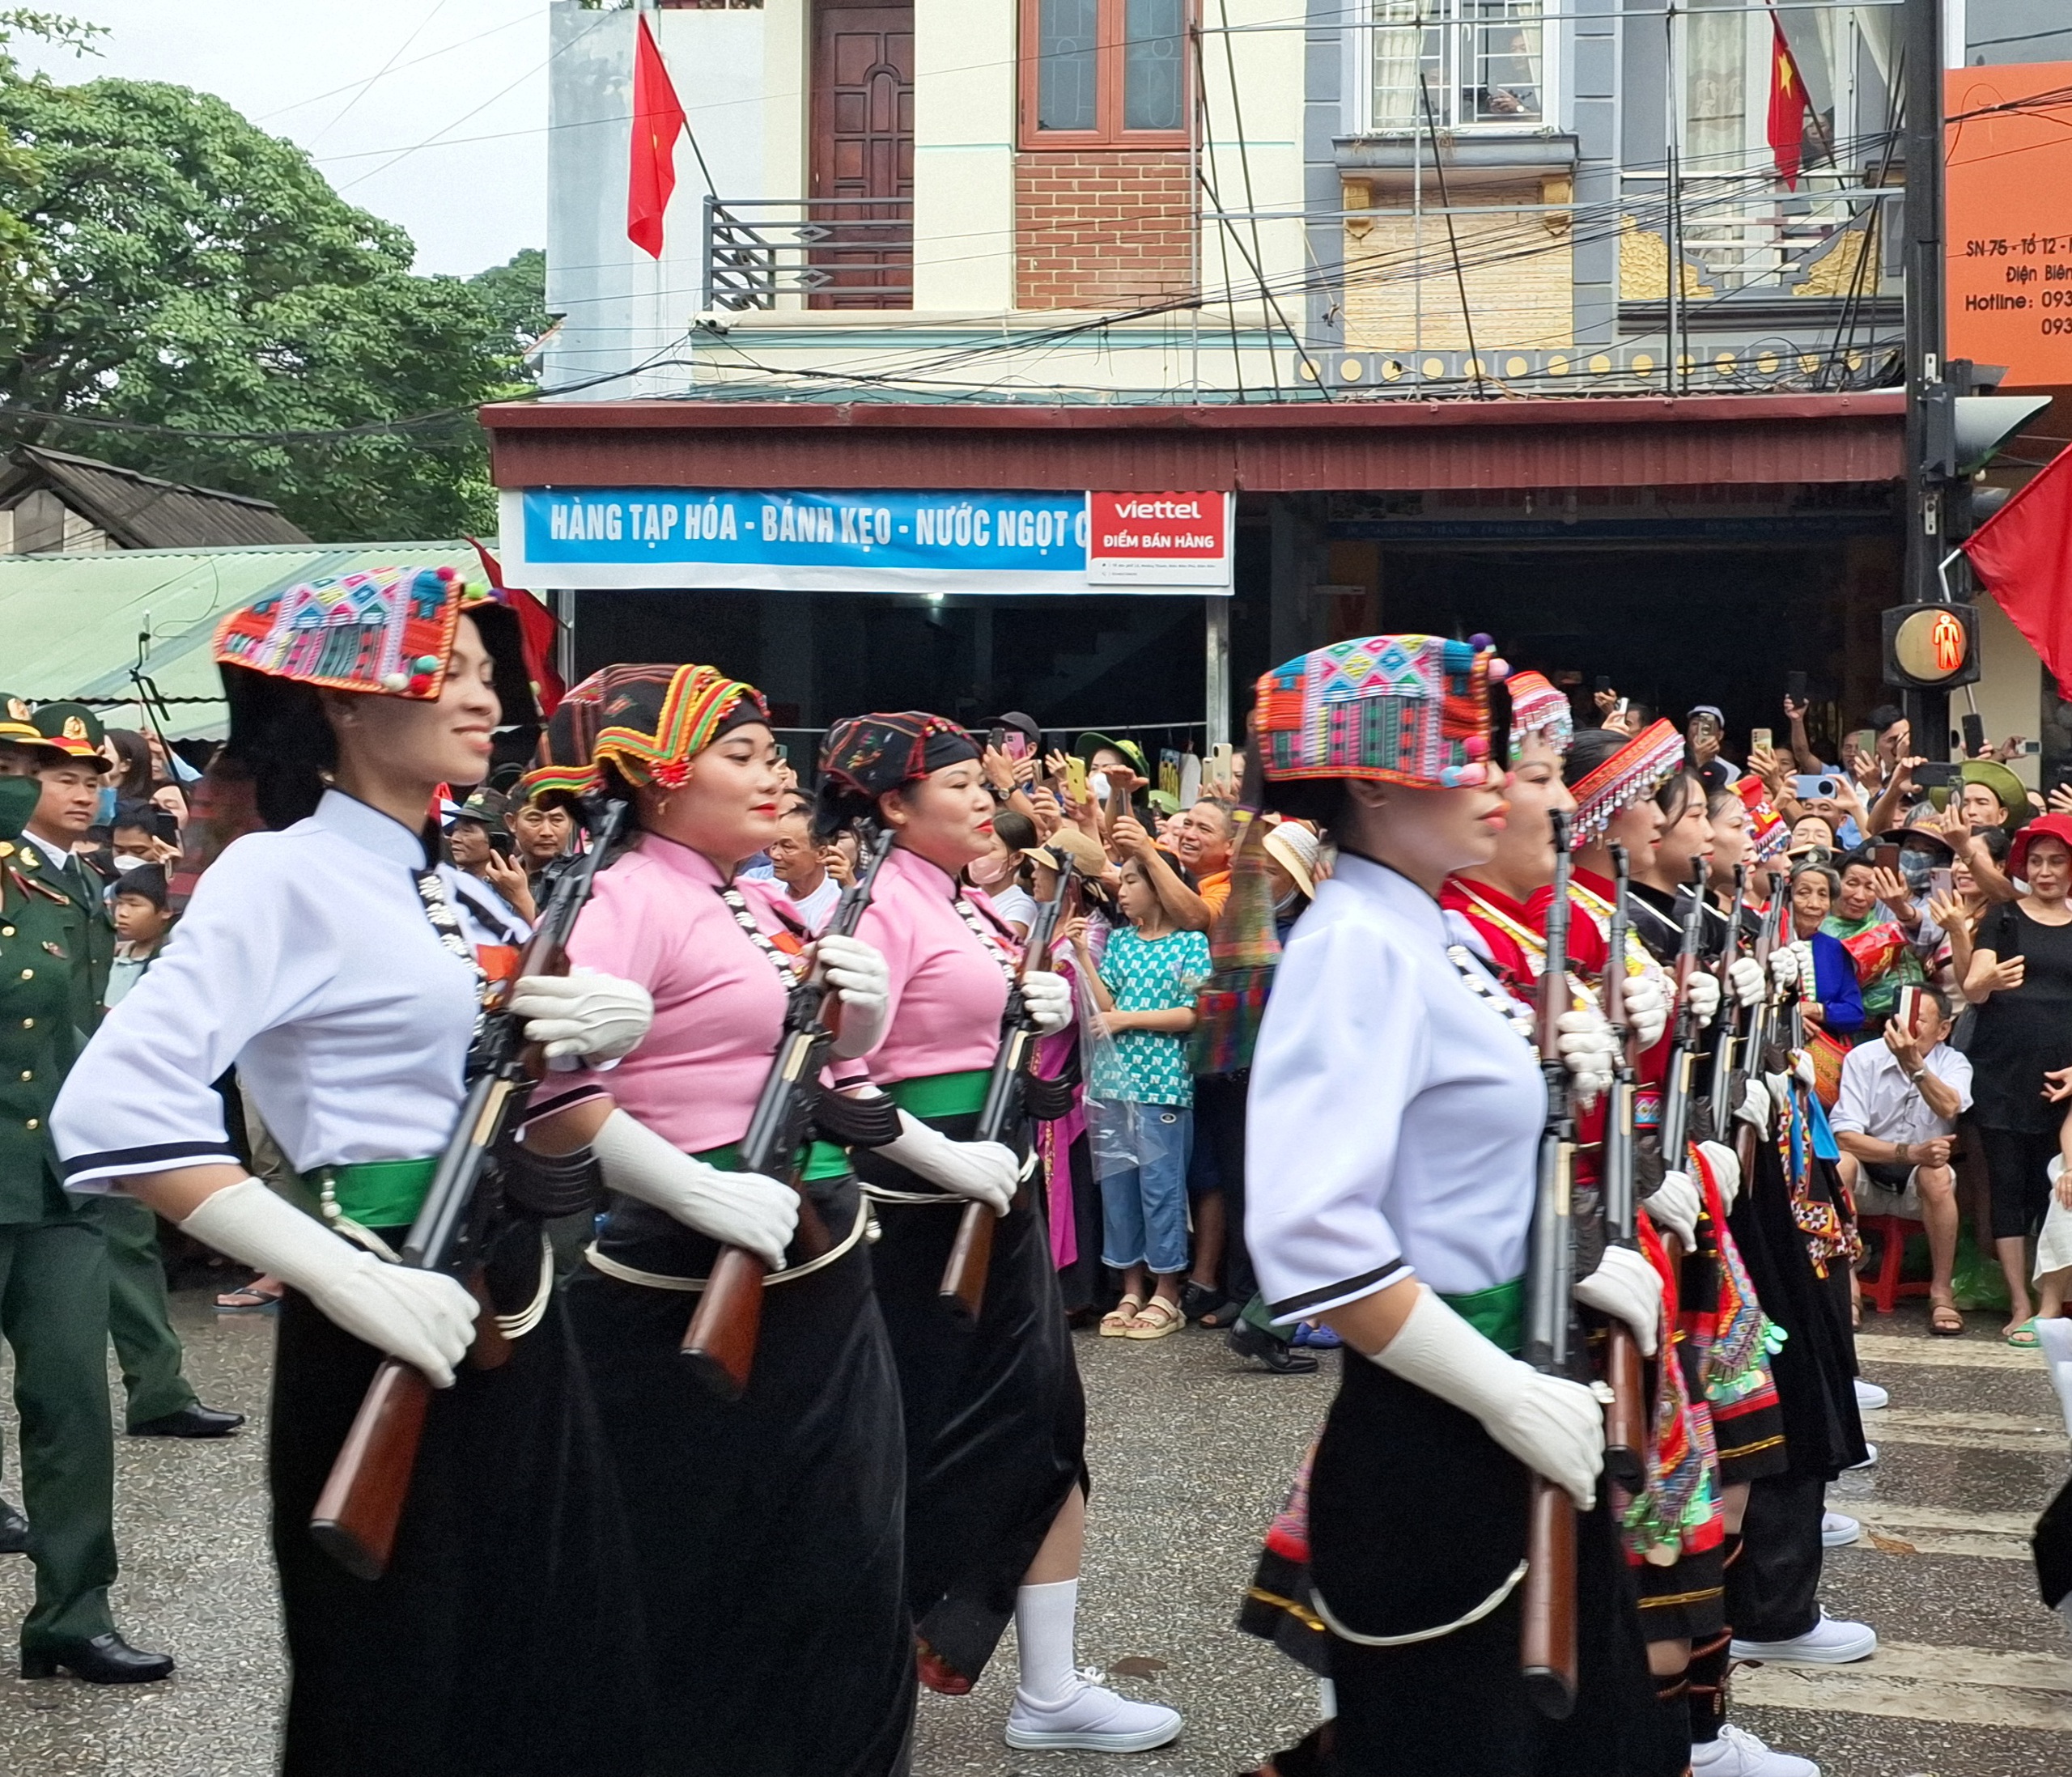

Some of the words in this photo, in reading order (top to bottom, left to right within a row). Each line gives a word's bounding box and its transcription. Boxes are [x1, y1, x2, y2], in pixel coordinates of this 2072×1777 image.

[1967, 240, 1985, 257] SN
[1989, 239, 2008, 256] 75
[2021, 232, 2036, 255] Tổ
[2042, 237, 2057, 255] 12
[2006, 265, 2037, 285] Điện
[2045, 263, 2072, 281] Biên
[1965, 293, 2033, 312] Hotline:
[1115, 500, 1202, 519] viettel
[551, 497, 622, 541] HÀNG
[630, 504, 678, 549] TẠP
[685, 496, 737, 541] HÓA
[762, 499, 834, 543] BÁNH
[840, 507, 891, 553] KẸO
[916, 502, 990, 547] NƯỚC
[998, 510, 1068, 555] NGỌT
[1103, 529, 1139, 548] ĐIỂM
[1142, 532, 1171, 548] BÁN
[1175, 532, 1215, 549] HÀNG
